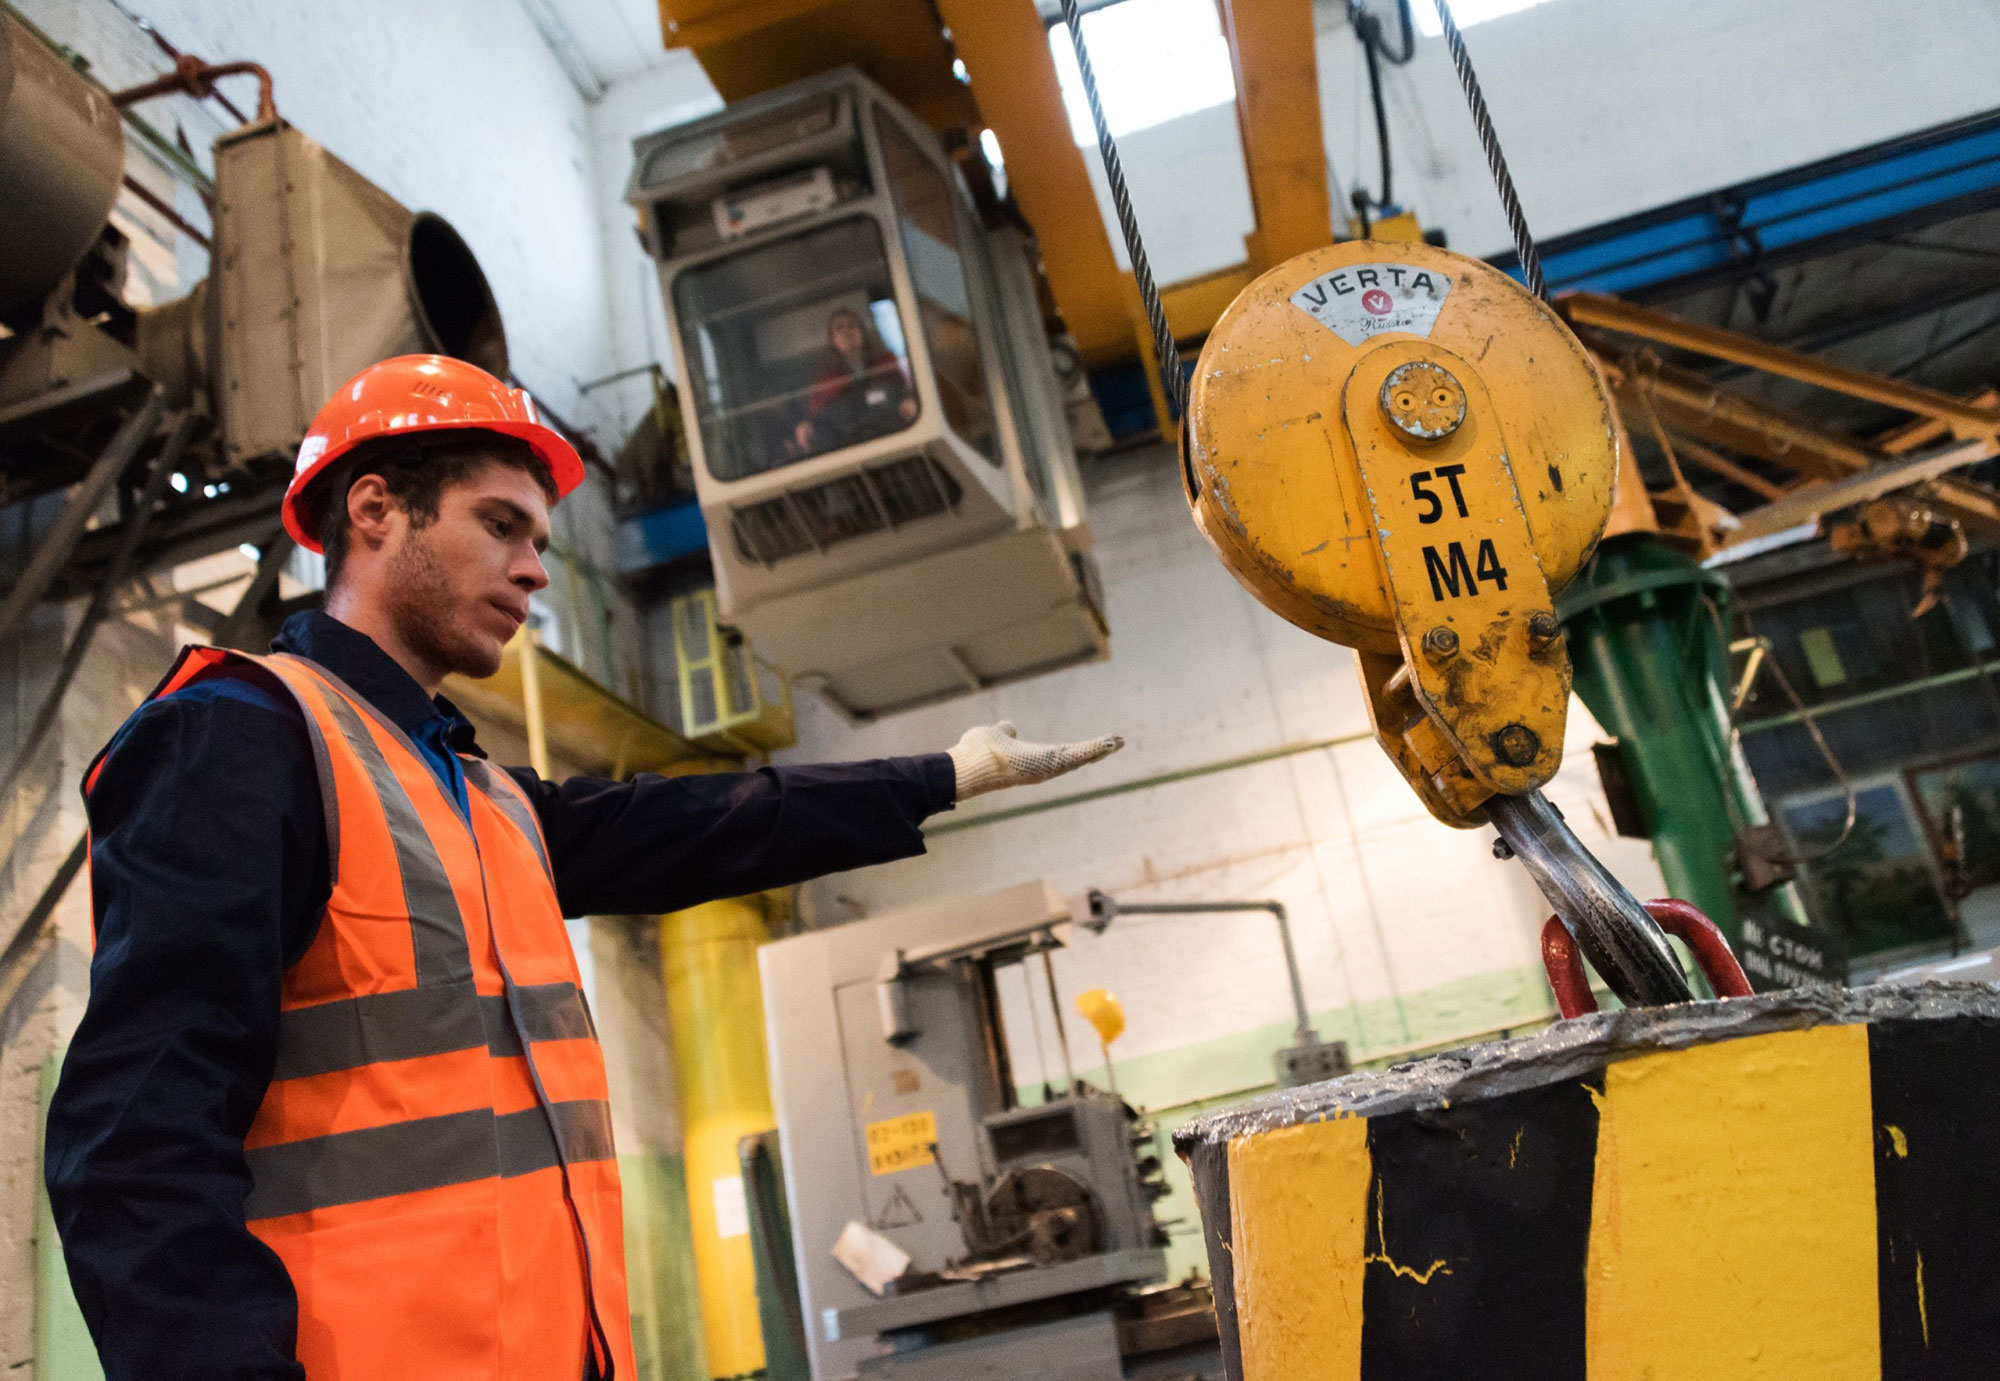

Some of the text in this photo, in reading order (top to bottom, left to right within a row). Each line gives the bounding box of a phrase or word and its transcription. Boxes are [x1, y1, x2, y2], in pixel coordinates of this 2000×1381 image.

[1302, 268, 1434, 306] VERTA
[1410, 463, 1469, 525] 5T
[1421, 538, 1509, 602] M4
